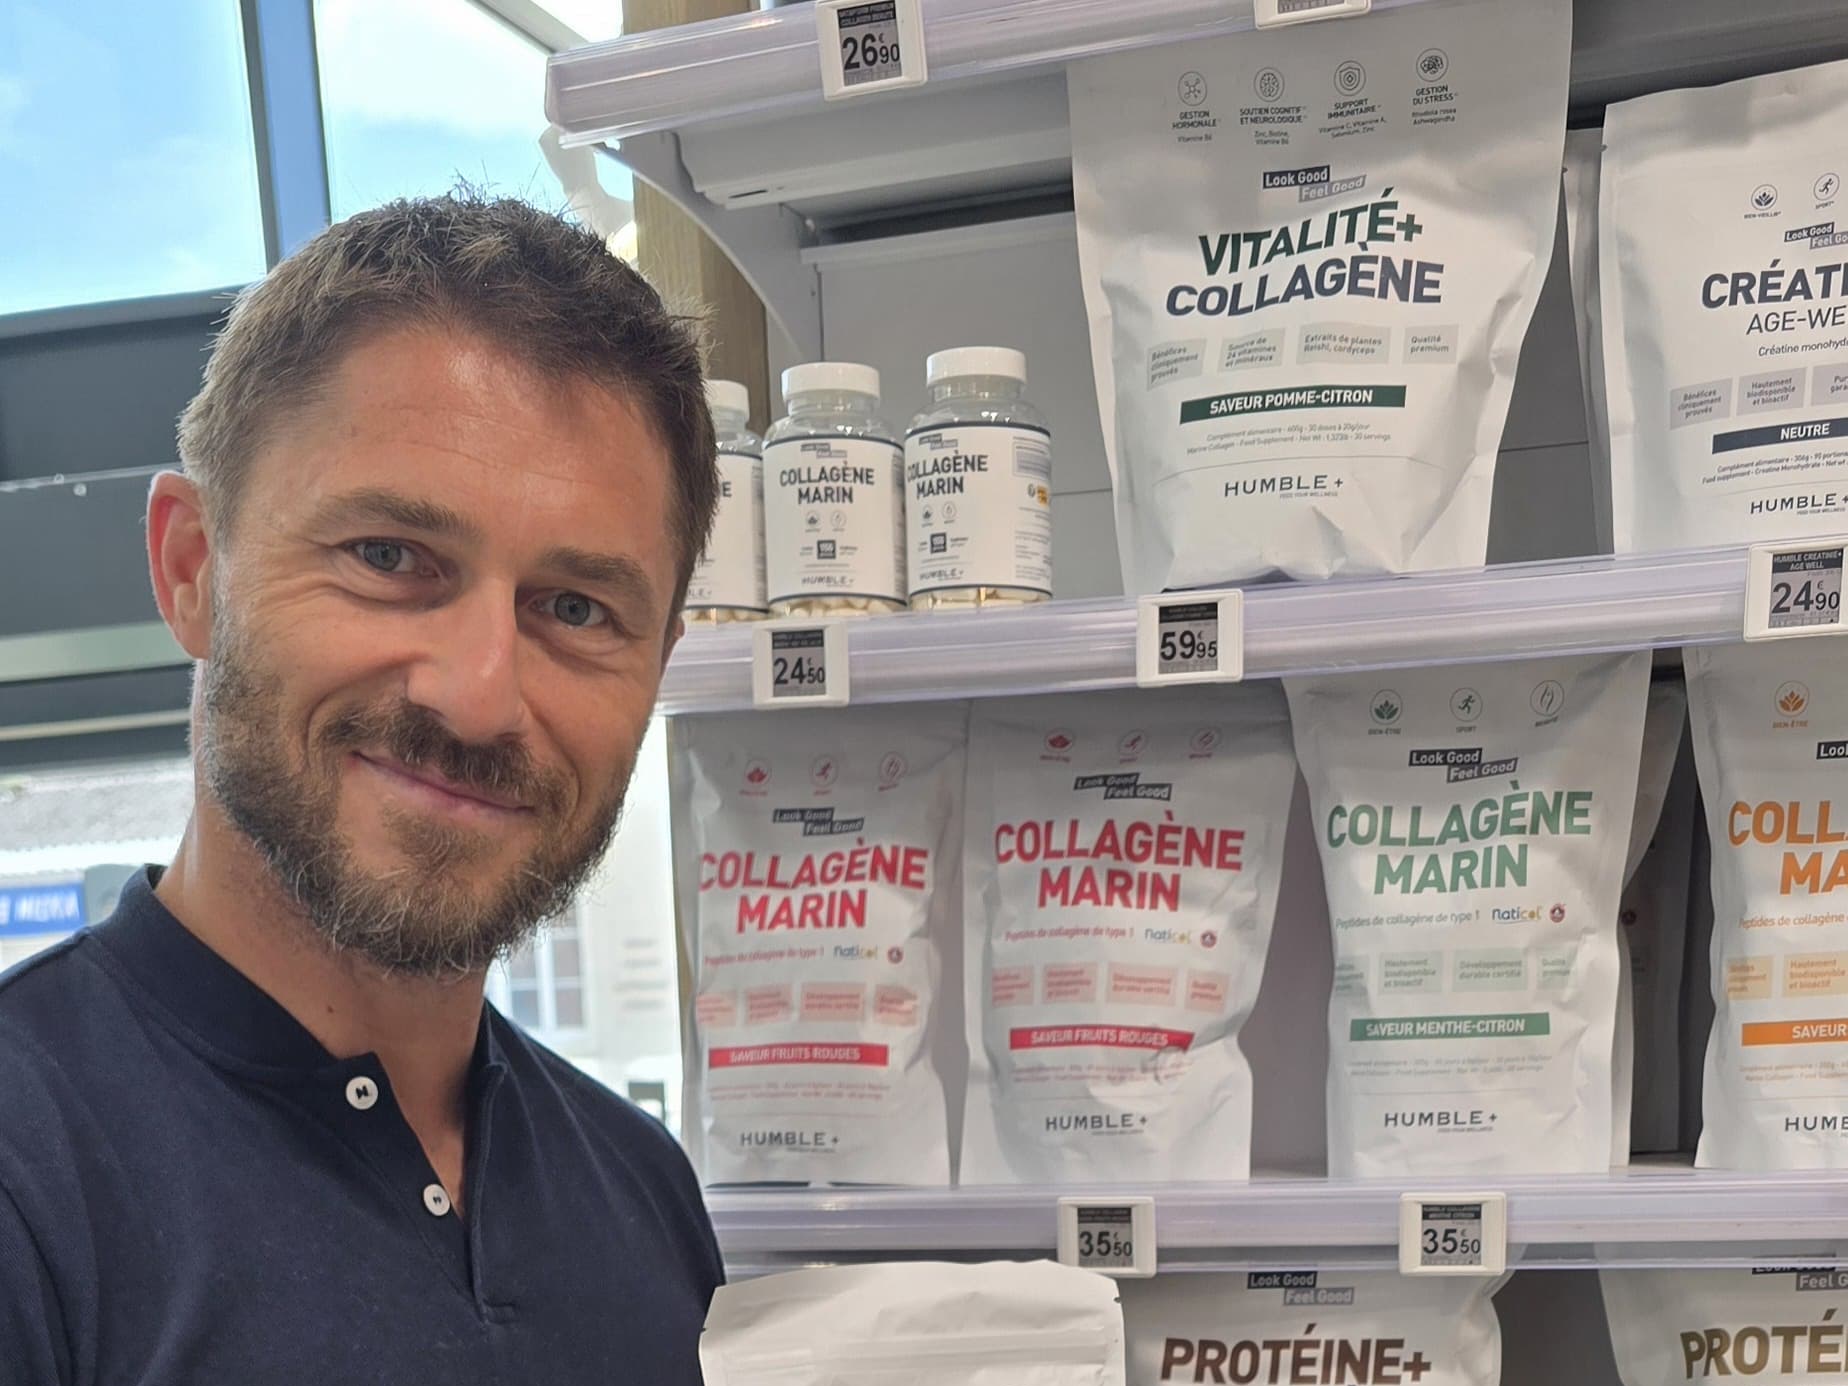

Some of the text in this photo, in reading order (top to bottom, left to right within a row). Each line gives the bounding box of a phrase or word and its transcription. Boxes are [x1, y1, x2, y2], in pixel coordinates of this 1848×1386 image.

[1266, 167, 1328, 187] Look Good
[1301, 176, 1364, 200] Feel Good
[1198, 186, 1423, 276] VITALITÉ+
[1786, 225, 1832, 242] Look Good
[1811, 237, 1832, 248] Feel
[1166, 241, 1444, 317] COLLAGÈNE
[1338, 335, 1348, 343] de
[1350, 336, 1382, 348] plantes
[1758, 345, 1799, 357] Créatine
[1752, 377, 1792, 390] Hautement
[1210, 389, 1373, 415] SAVEUR POMME-CITRON
[1780, 423, 1831, 440] NEUTRE
[780, 460, 875, 487] COLLAGÈNE
[907, 449, 988, 482] COLLAGÈNE
[797, 485, 854, 504] MARIN
[916, 475, 964, 499] MARIN
[1411, 750, 1480, 765] Look Good
[1450, 760, 1516, 781] Feel Good
[1136, 786, 1169, 798] Good
[1327, 779, 1593, 849] COLLAGÈNE
[994, 809, 1246, 872] COLLAGÈNE
[700, 836, 929, 893] COLLAGÈNE
[1374, 843, 1529, 895] MARIN
[1037, 866, 1181, 912] MARIN
[737, 889, 867, 934] MARIN
[1335, 917, 1372, 930] Peptides
[1374, 916, 1384, 927] de
[1386, 913, 1433, 927] collagène
[1437, 913, 1447, 923] de
[1450, 912, 1472, 925] type
[1778, 913, 1844, 926] de collagène
[1031, 1028, 1168, 1046] SAVEUR FRUITS ROUGES
[1366, 1018, 1526, 1037] SAVEUR MENTHE-CITRON
[1792, 1024, 1846, 1039] SAVEUR
[812, 1047, 860, 1060] ROUGES
[1251, 1273, 1315, 1288] Look Good
[1799, 1274, 1833, 1288] Feel
[1285, 1289, 1353, 1304] Feel Good
[1160, 1323, 1432, 1386] PROTÉINE+
